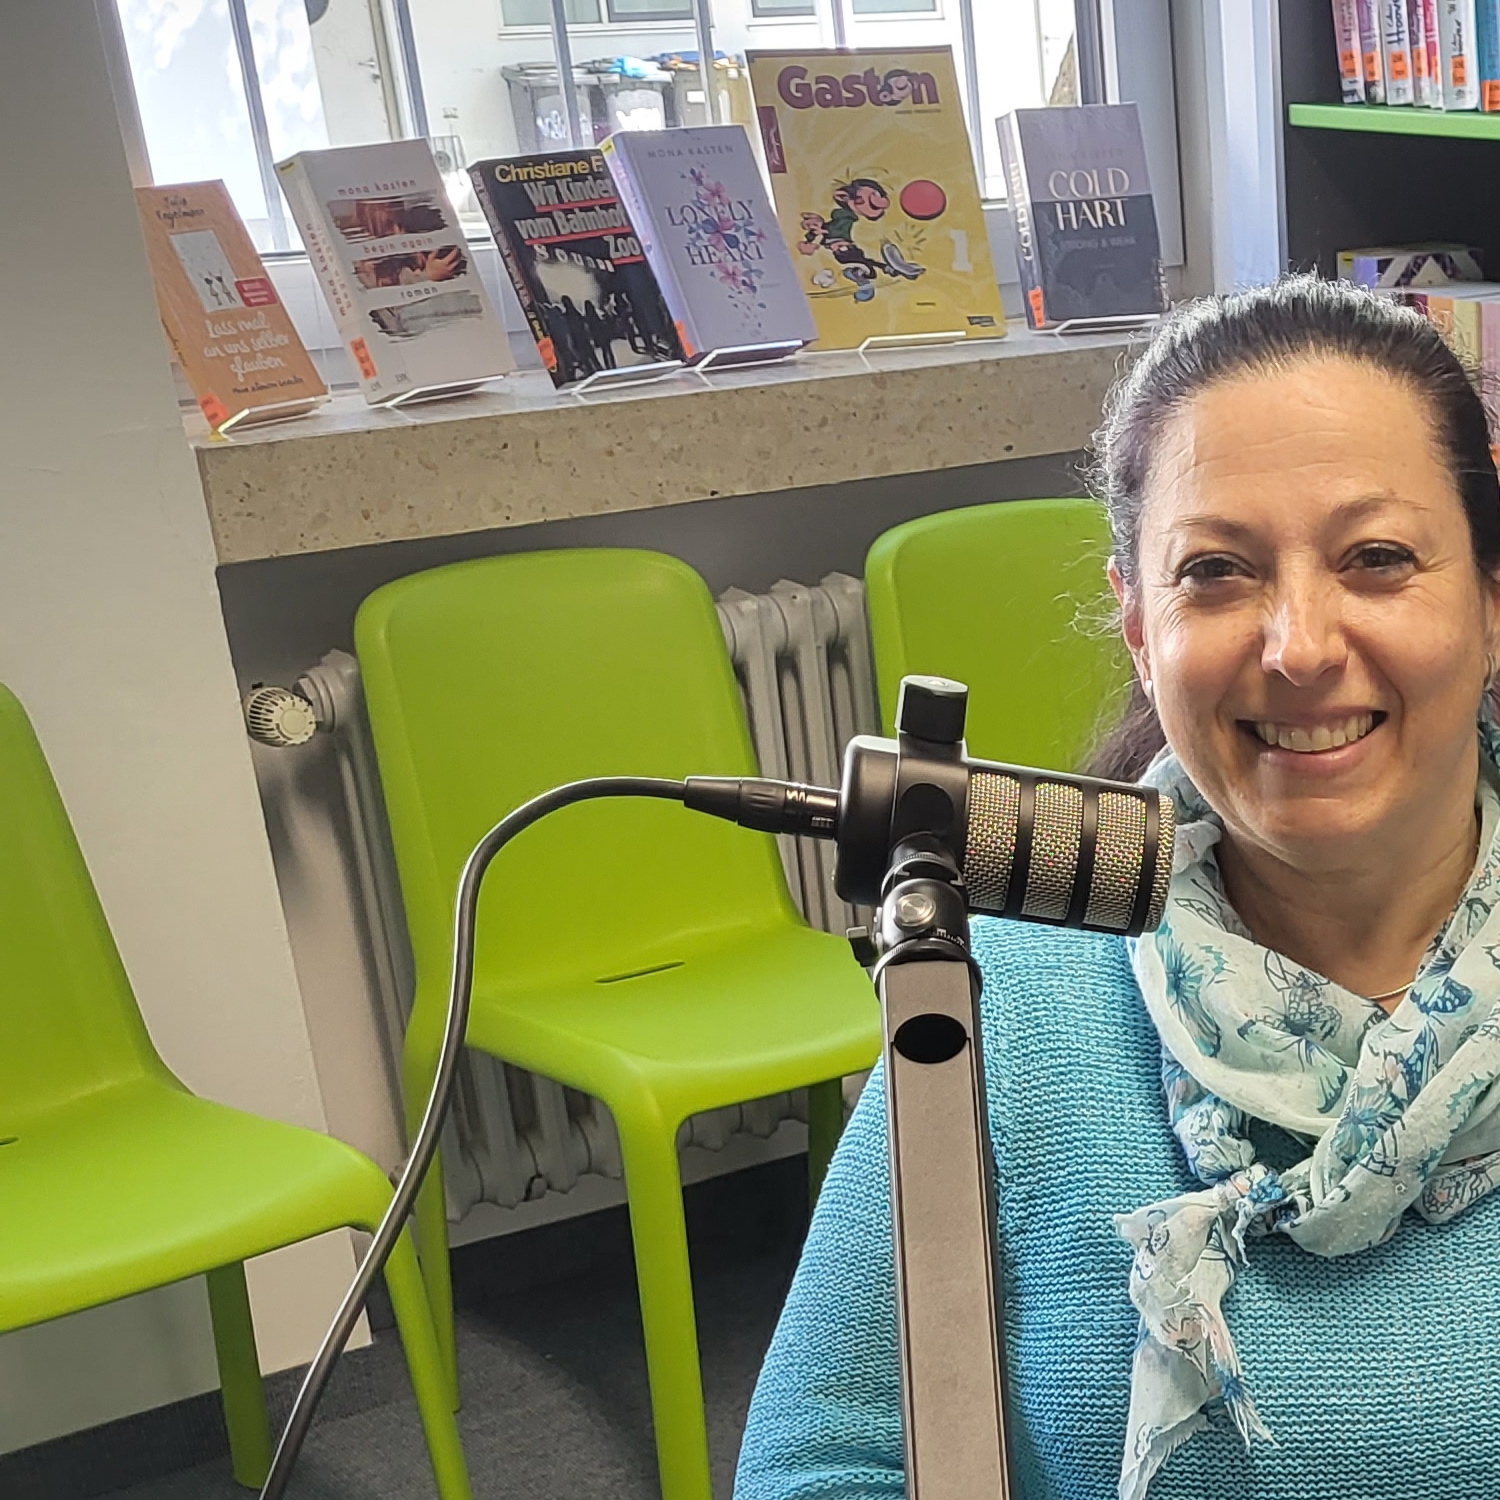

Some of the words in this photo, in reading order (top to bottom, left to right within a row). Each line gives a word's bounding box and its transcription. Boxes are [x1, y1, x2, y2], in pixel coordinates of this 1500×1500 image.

[495, 160, 590, 183] Christiane
[1049, 167, 1130, 199] COLD
[1055, 198, 1128, 231] HART
[514, 217, 555, 239] vom
[603, 235, 641, 258] Zoo
[684, 245, 764, 266] HEART
